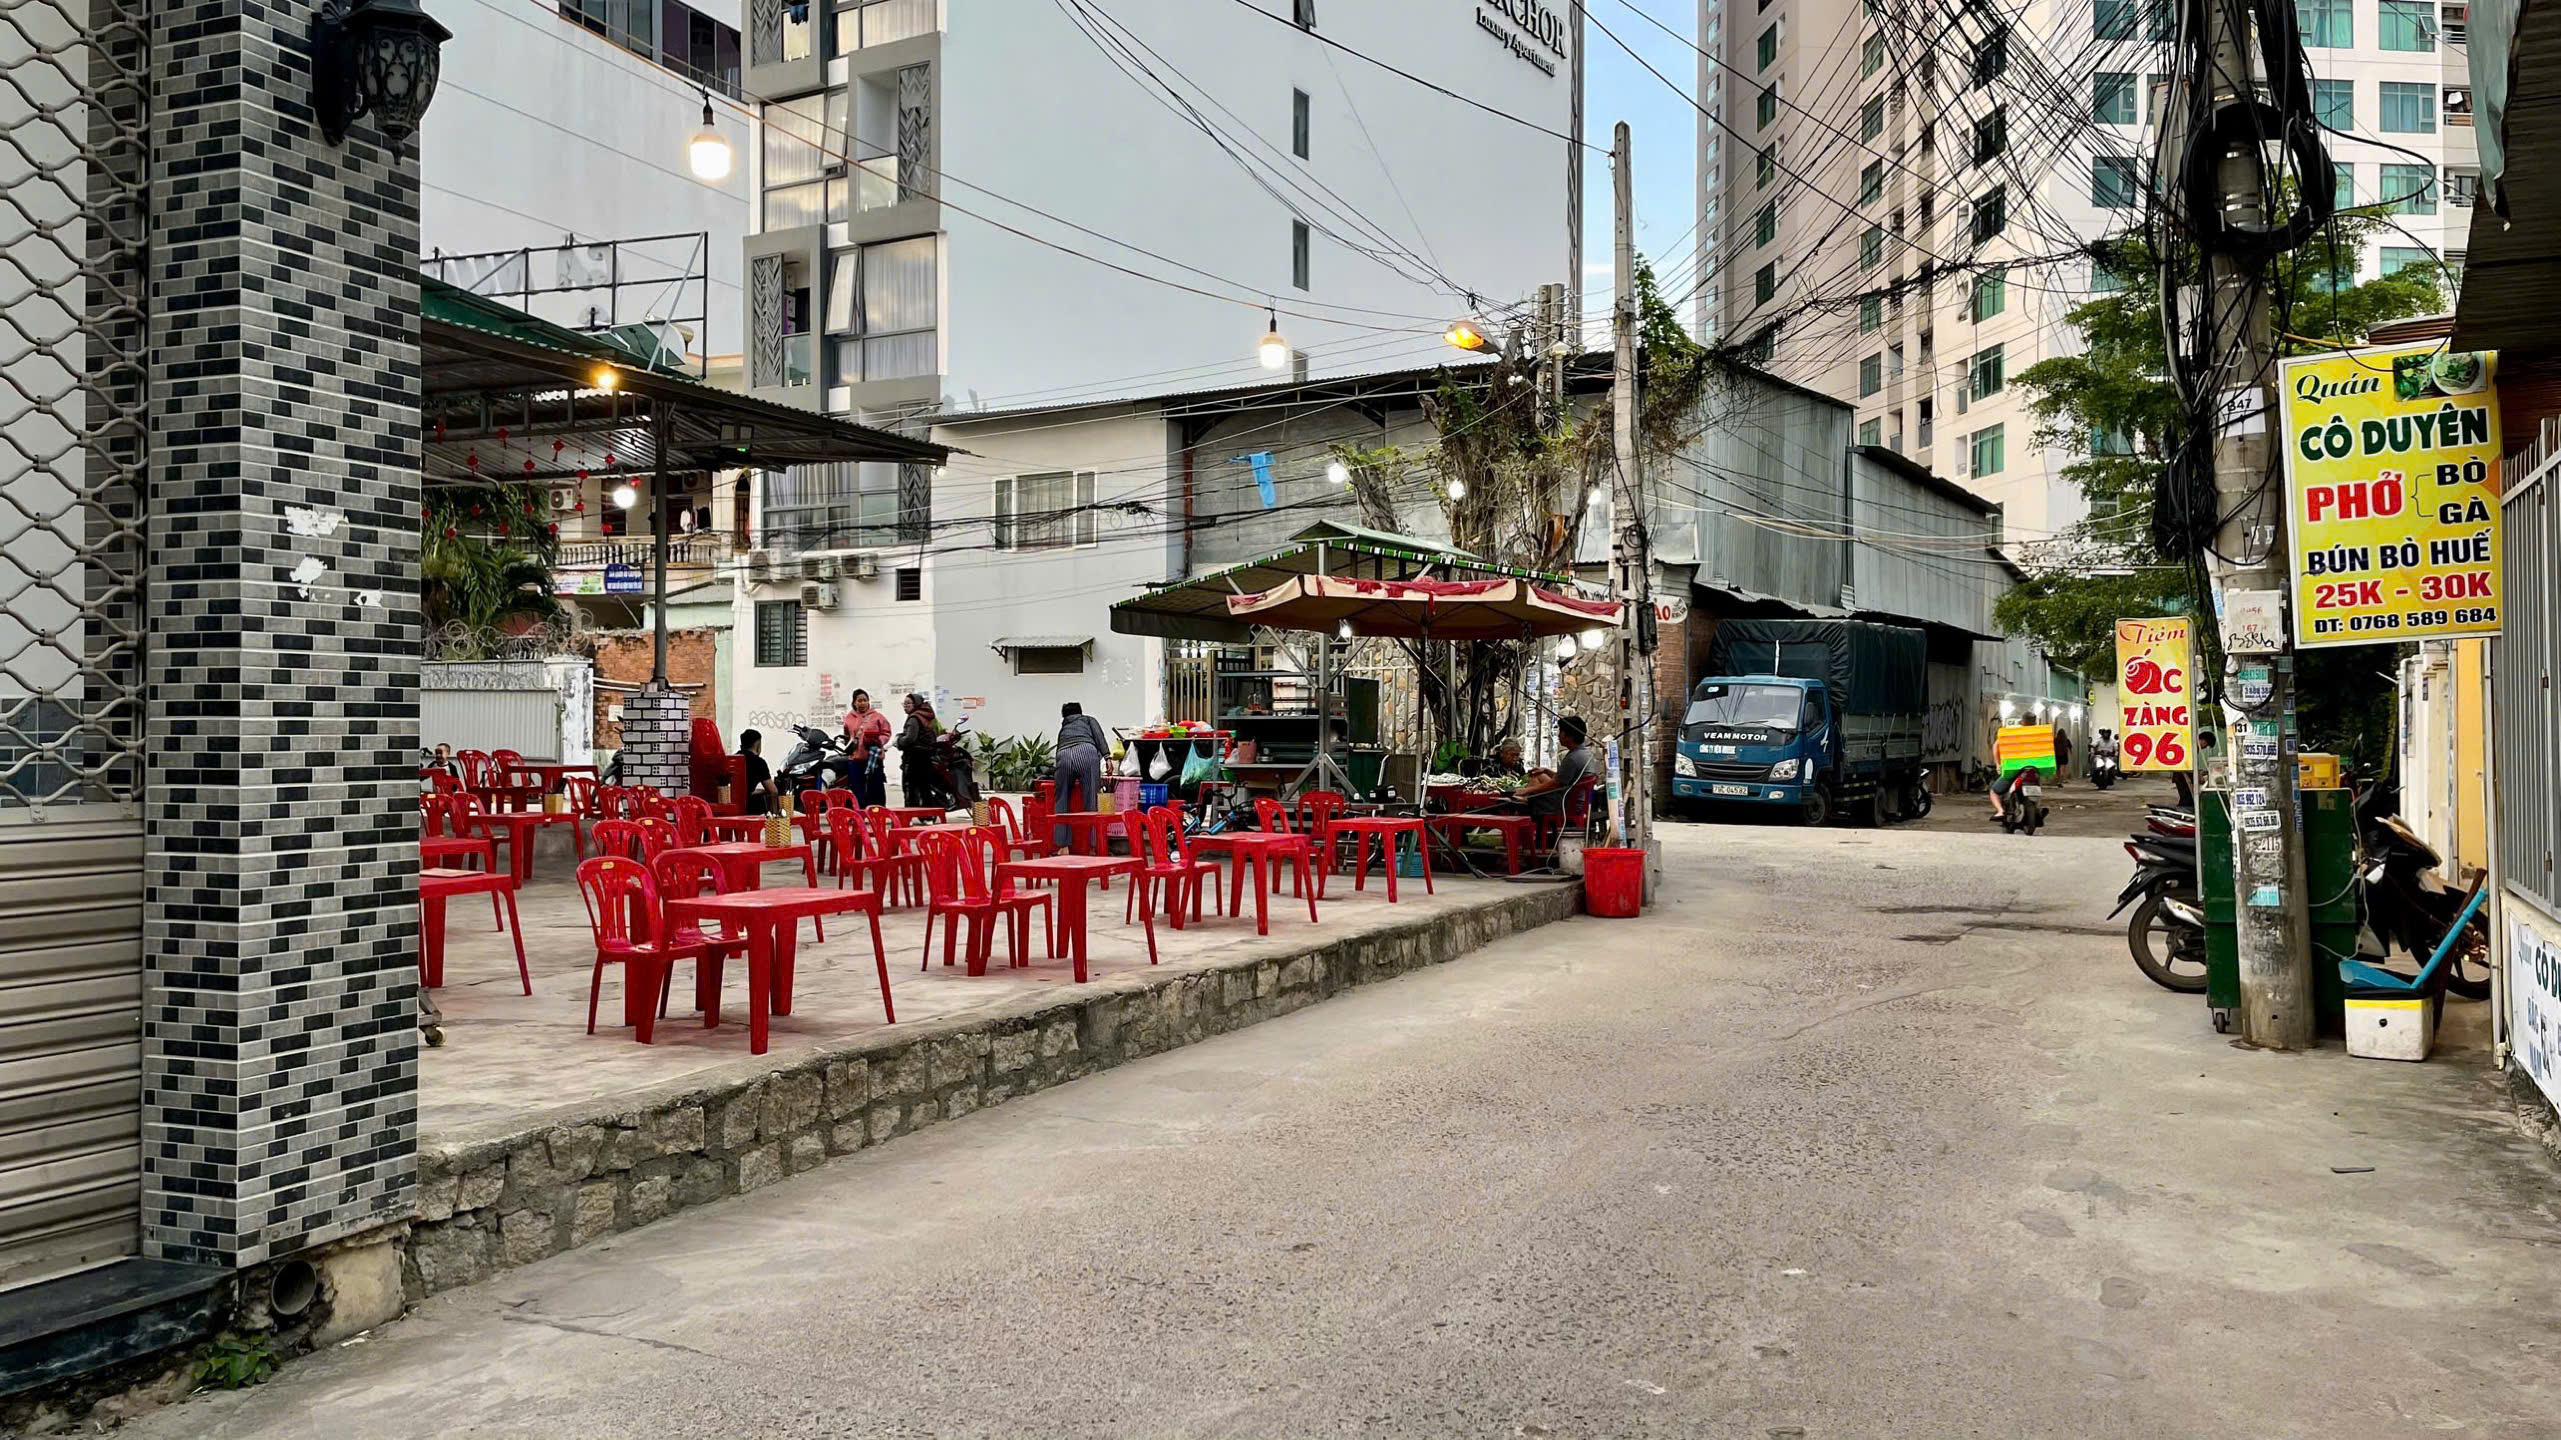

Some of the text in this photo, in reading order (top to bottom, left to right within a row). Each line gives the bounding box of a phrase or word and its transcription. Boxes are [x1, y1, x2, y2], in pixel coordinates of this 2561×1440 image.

[1486, 0, 1567, 58] CHOR
[2296, 373, 2381, 405] Quán
[2300, 403, 2488, 461] CÔ DUYÊN
[2436, 456, 2488, 486] BÒ
[2306, 471, 2404, 522] PHỞ
[2439, 496, 2491, 524] GÀ
[2308, 528, 2491, 575] BÚN BÒ HUẾ
[2315, 580, 2384, 609] 25K
[2421, 572, 2493, 601] 30K
[2119, 623, 2185, 646] Tiệm
[2350, 614, 2400, 630] 0768
[2406, 610, 2448, 627] 589
[2455, 608, 2497, 623] 684
[2123, 701, 2189, 726] ZÀNG
[2123, 732, 2185, 766] 96
